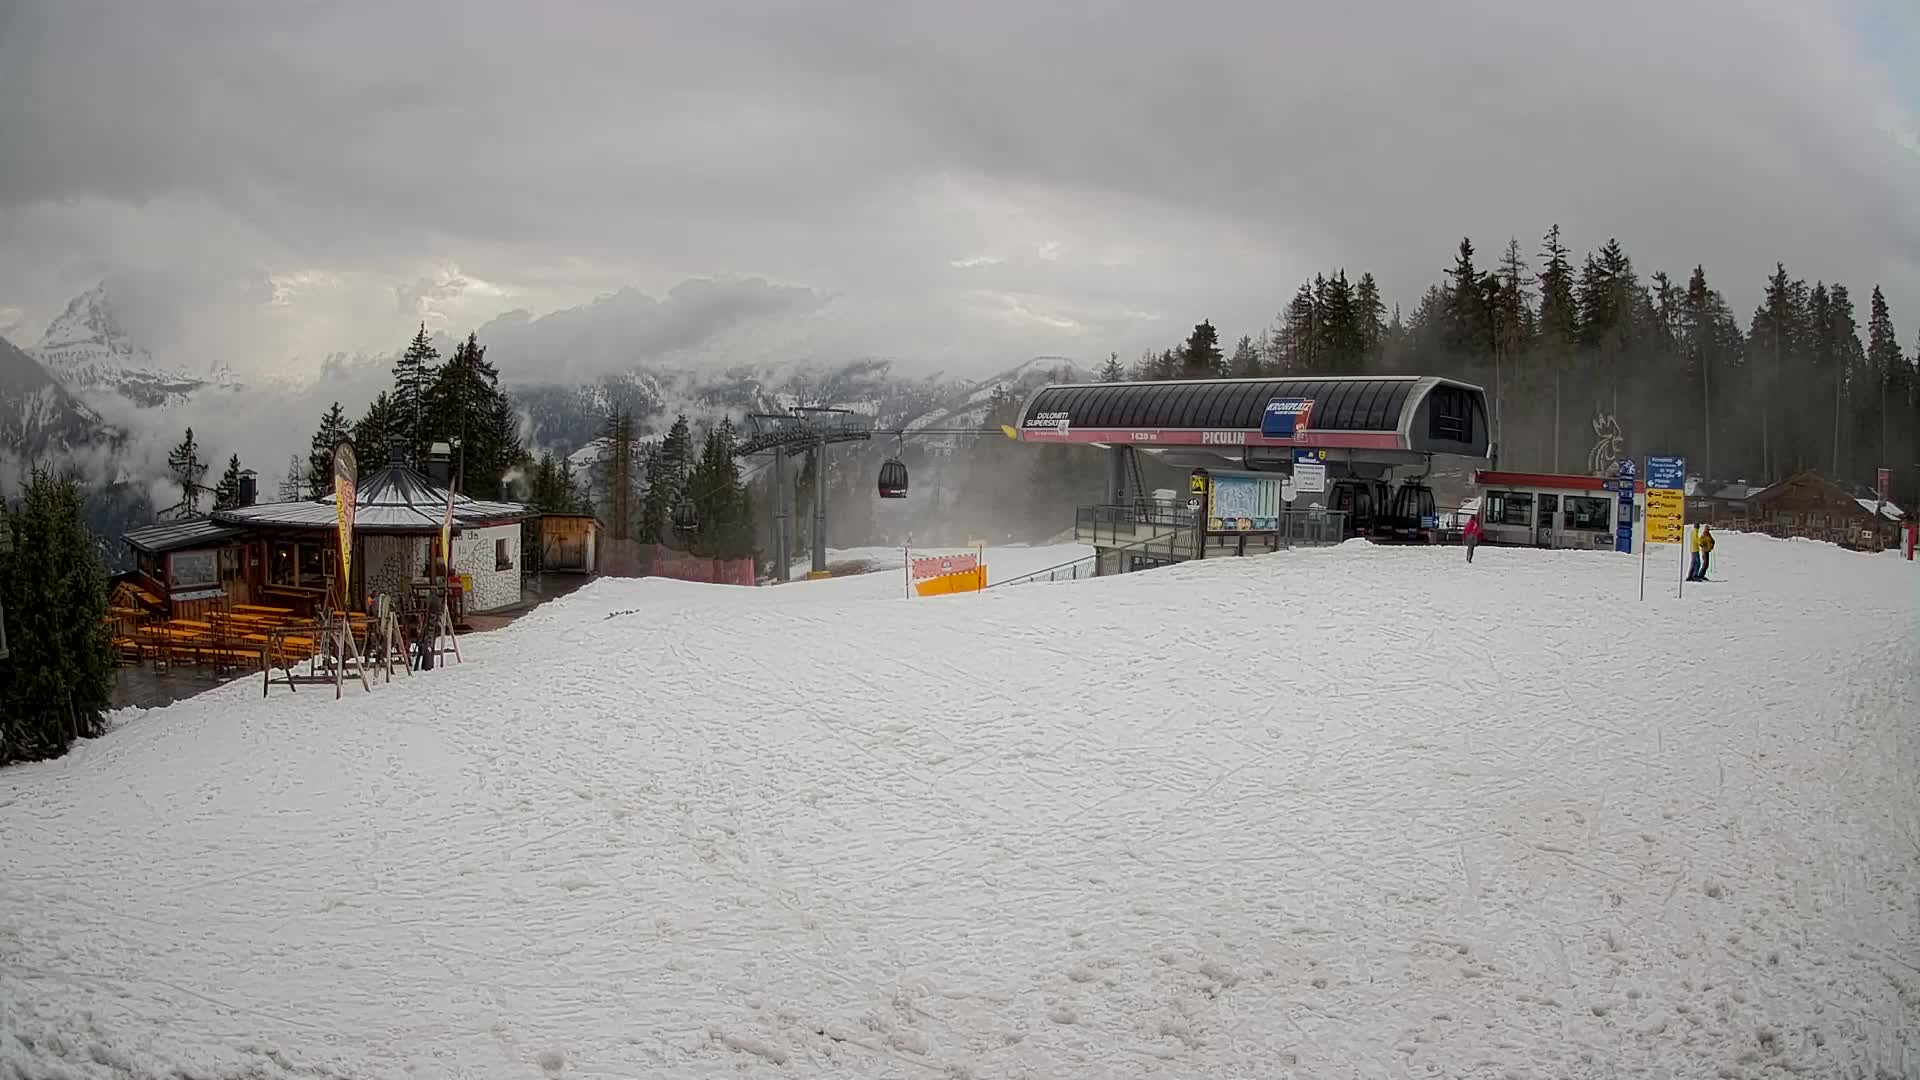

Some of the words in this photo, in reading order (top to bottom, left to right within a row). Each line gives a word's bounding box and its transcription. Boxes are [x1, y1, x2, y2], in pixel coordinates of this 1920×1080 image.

[1266, 402, 1312, 411] KRONPLATZ
[1026, 419, 1059, 427] SUPERSKI
[1202, 431, 1246, 444] PICULIN
